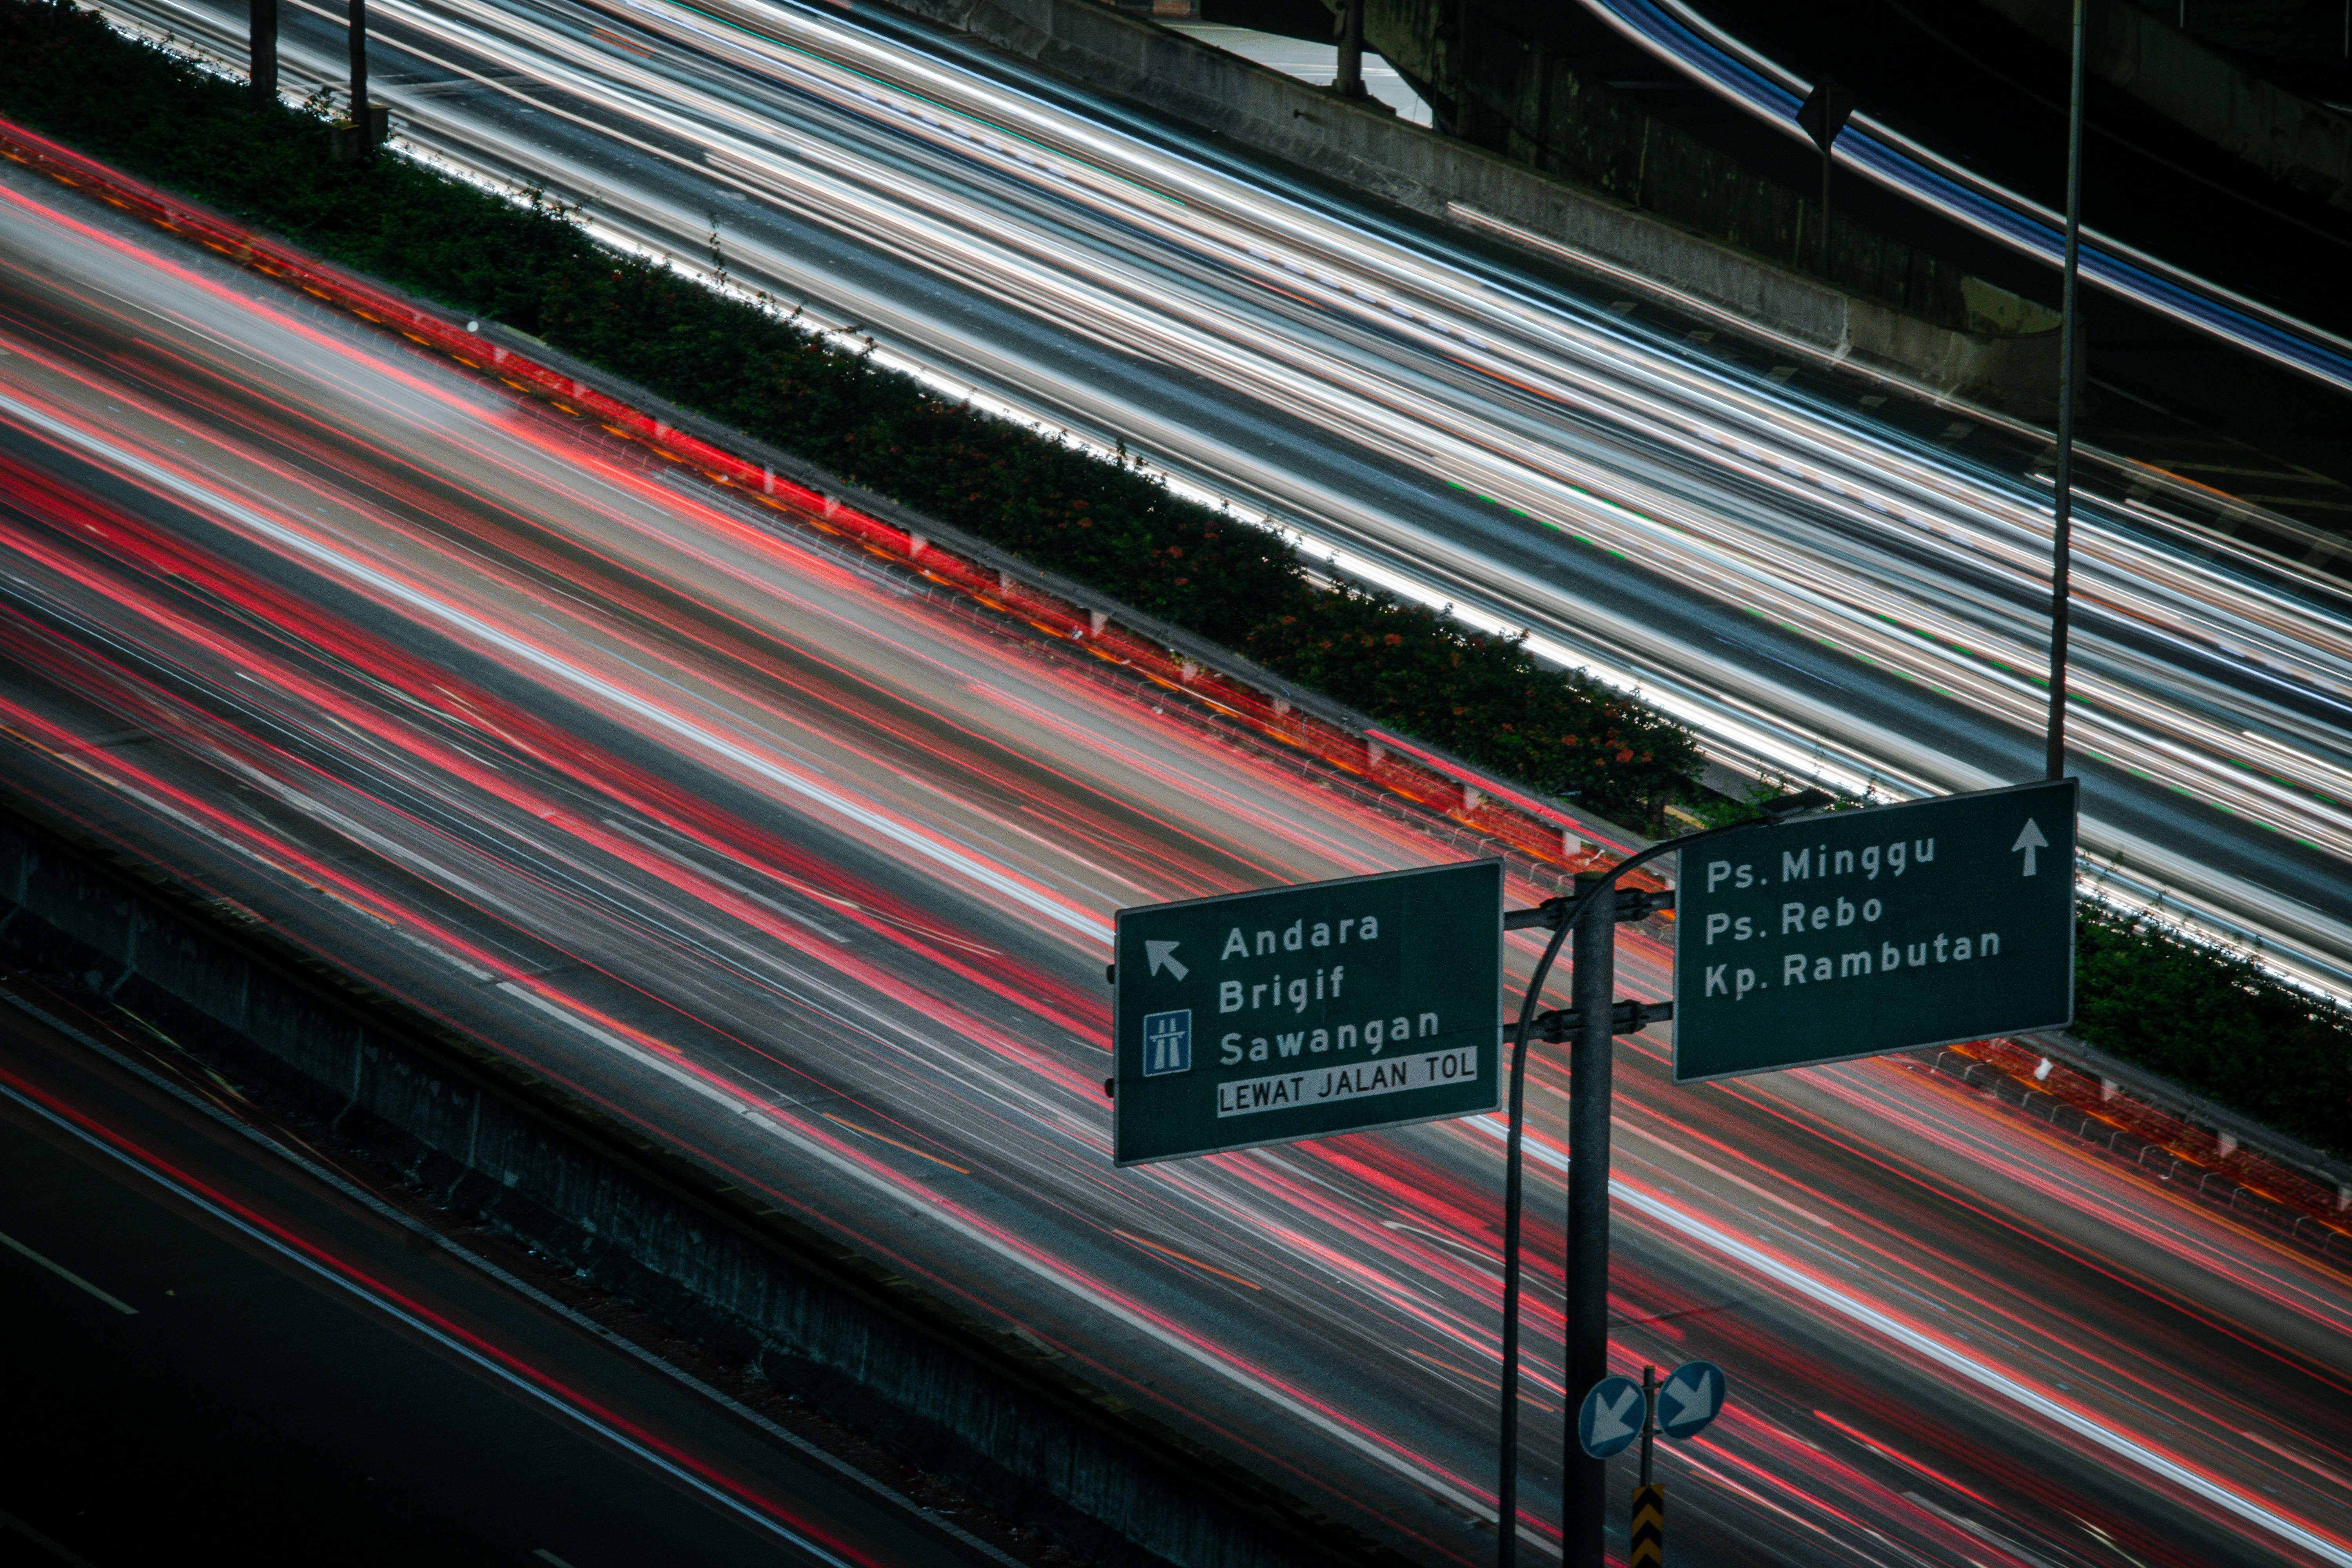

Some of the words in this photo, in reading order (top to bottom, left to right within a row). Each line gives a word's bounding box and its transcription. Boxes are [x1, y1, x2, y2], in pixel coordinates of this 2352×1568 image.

[1707, 860, 1767, 893] Ps.
[1782, 837, 1935, 880] Minggu
[1220, 916, 1379, 961] Andara
[1706, 912, 1767, 946] Ps.
[1782, 896, 1882, 935] Rebo
[1219, 965, 1344, 1014] Brigif
[1705, 964, 1768, 1001] Kp.
[1783, 932, 2000, 986] Rambutan
[1220, 1012, 1439, 1065] Sawangan
[1219, 1076, 1304, 1112] LEWAT
[1317, 1061, 1407, 1098] JALAN
[1425, 1052, 1475, 1081] TOL
